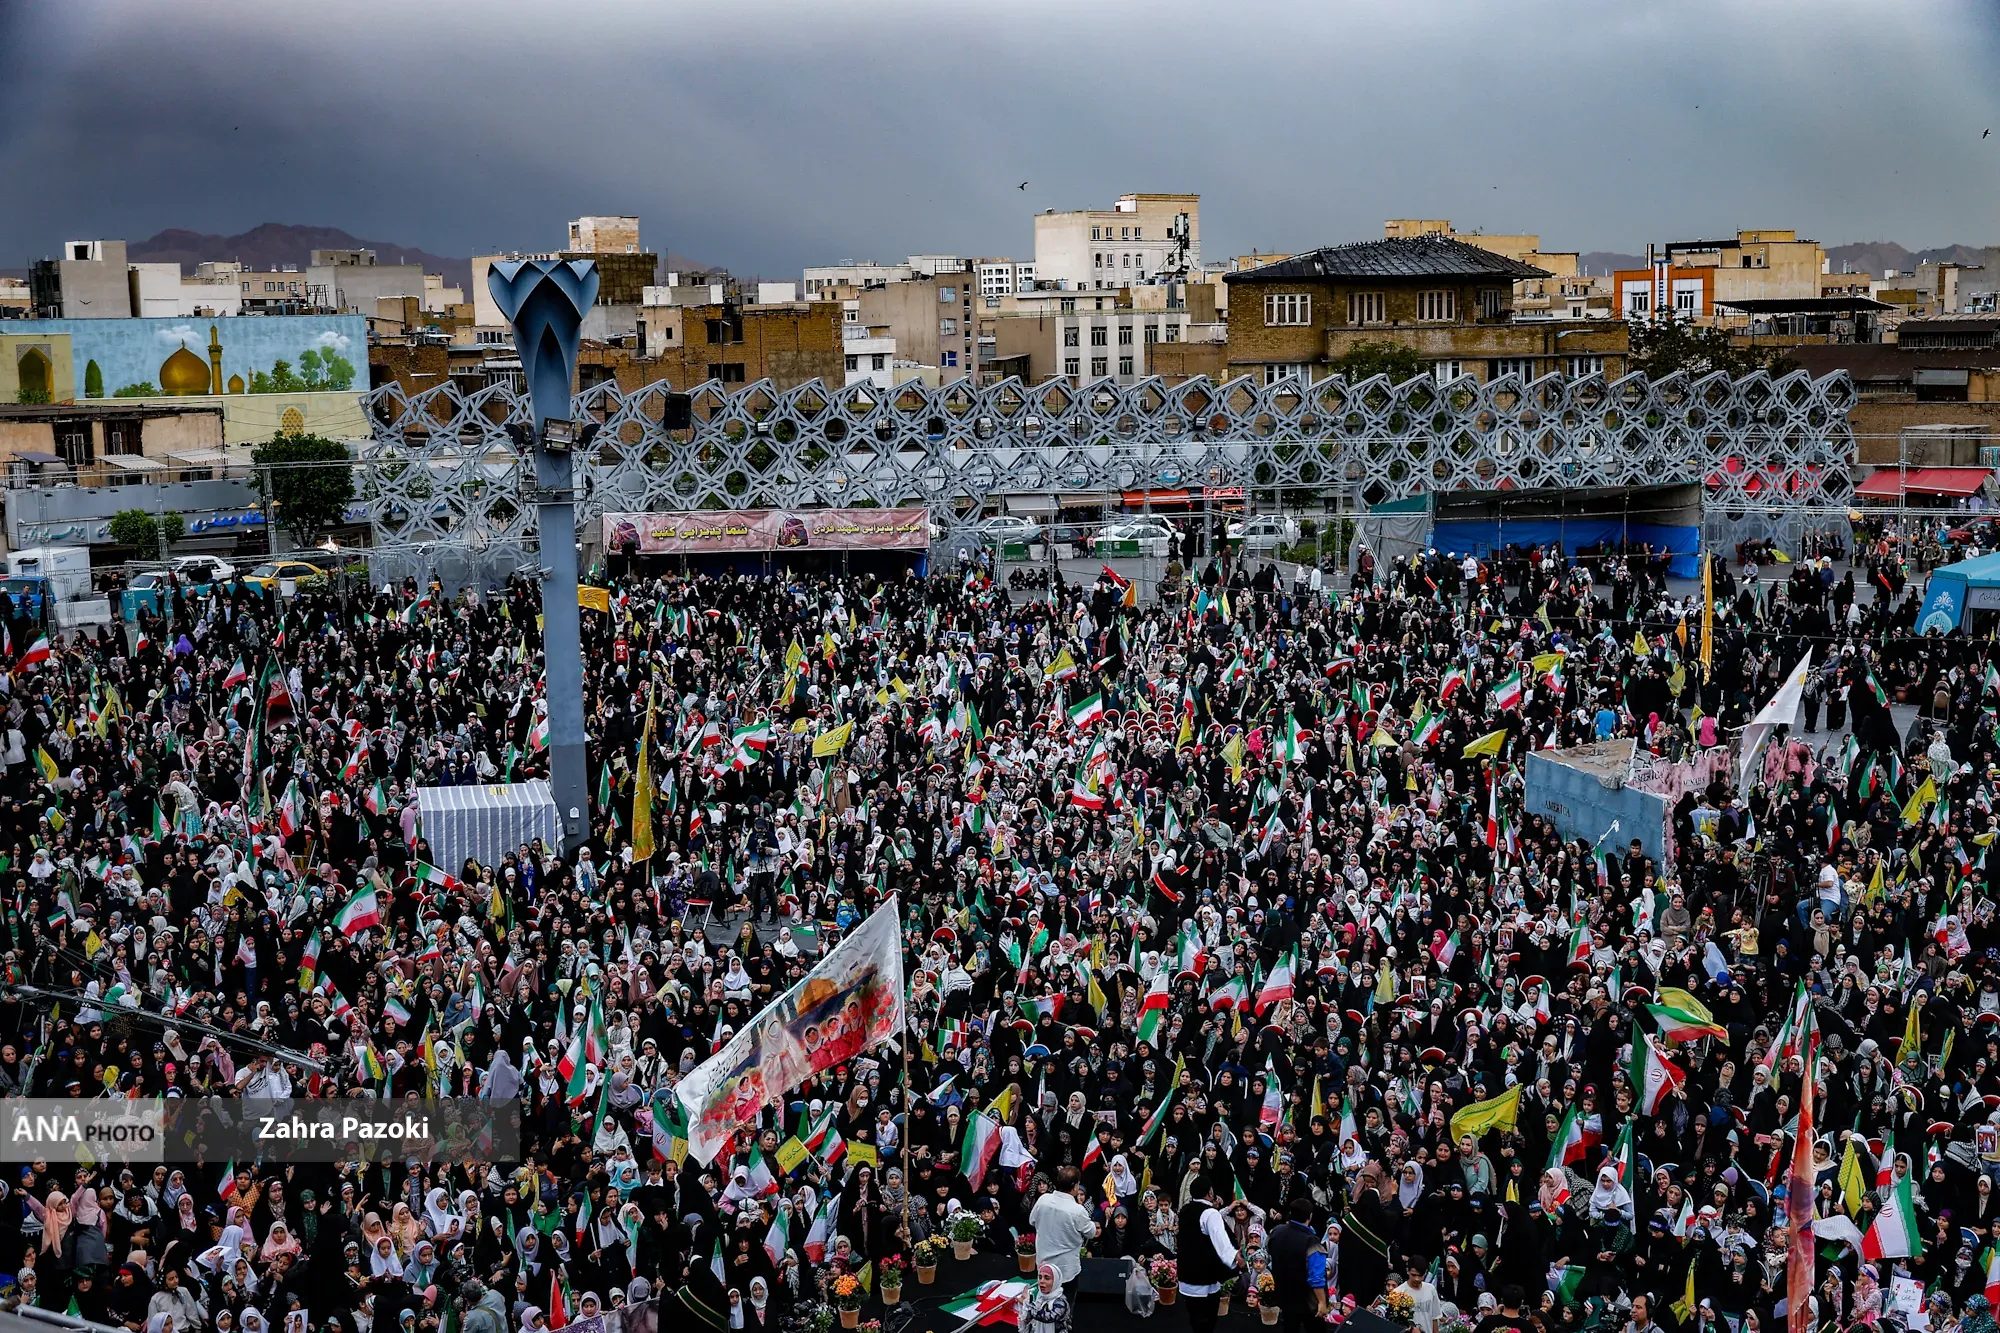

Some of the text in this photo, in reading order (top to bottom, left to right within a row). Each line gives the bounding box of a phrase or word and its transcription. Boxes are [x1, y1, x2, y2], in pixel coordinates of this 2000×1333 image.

[651, 522, 748, 541] شما پذیرایی کنید
[837, 522, 860, 534] شهید
[862, 523, 893, 536] پذیرایی
[895, 523, 920, 534] موکب
